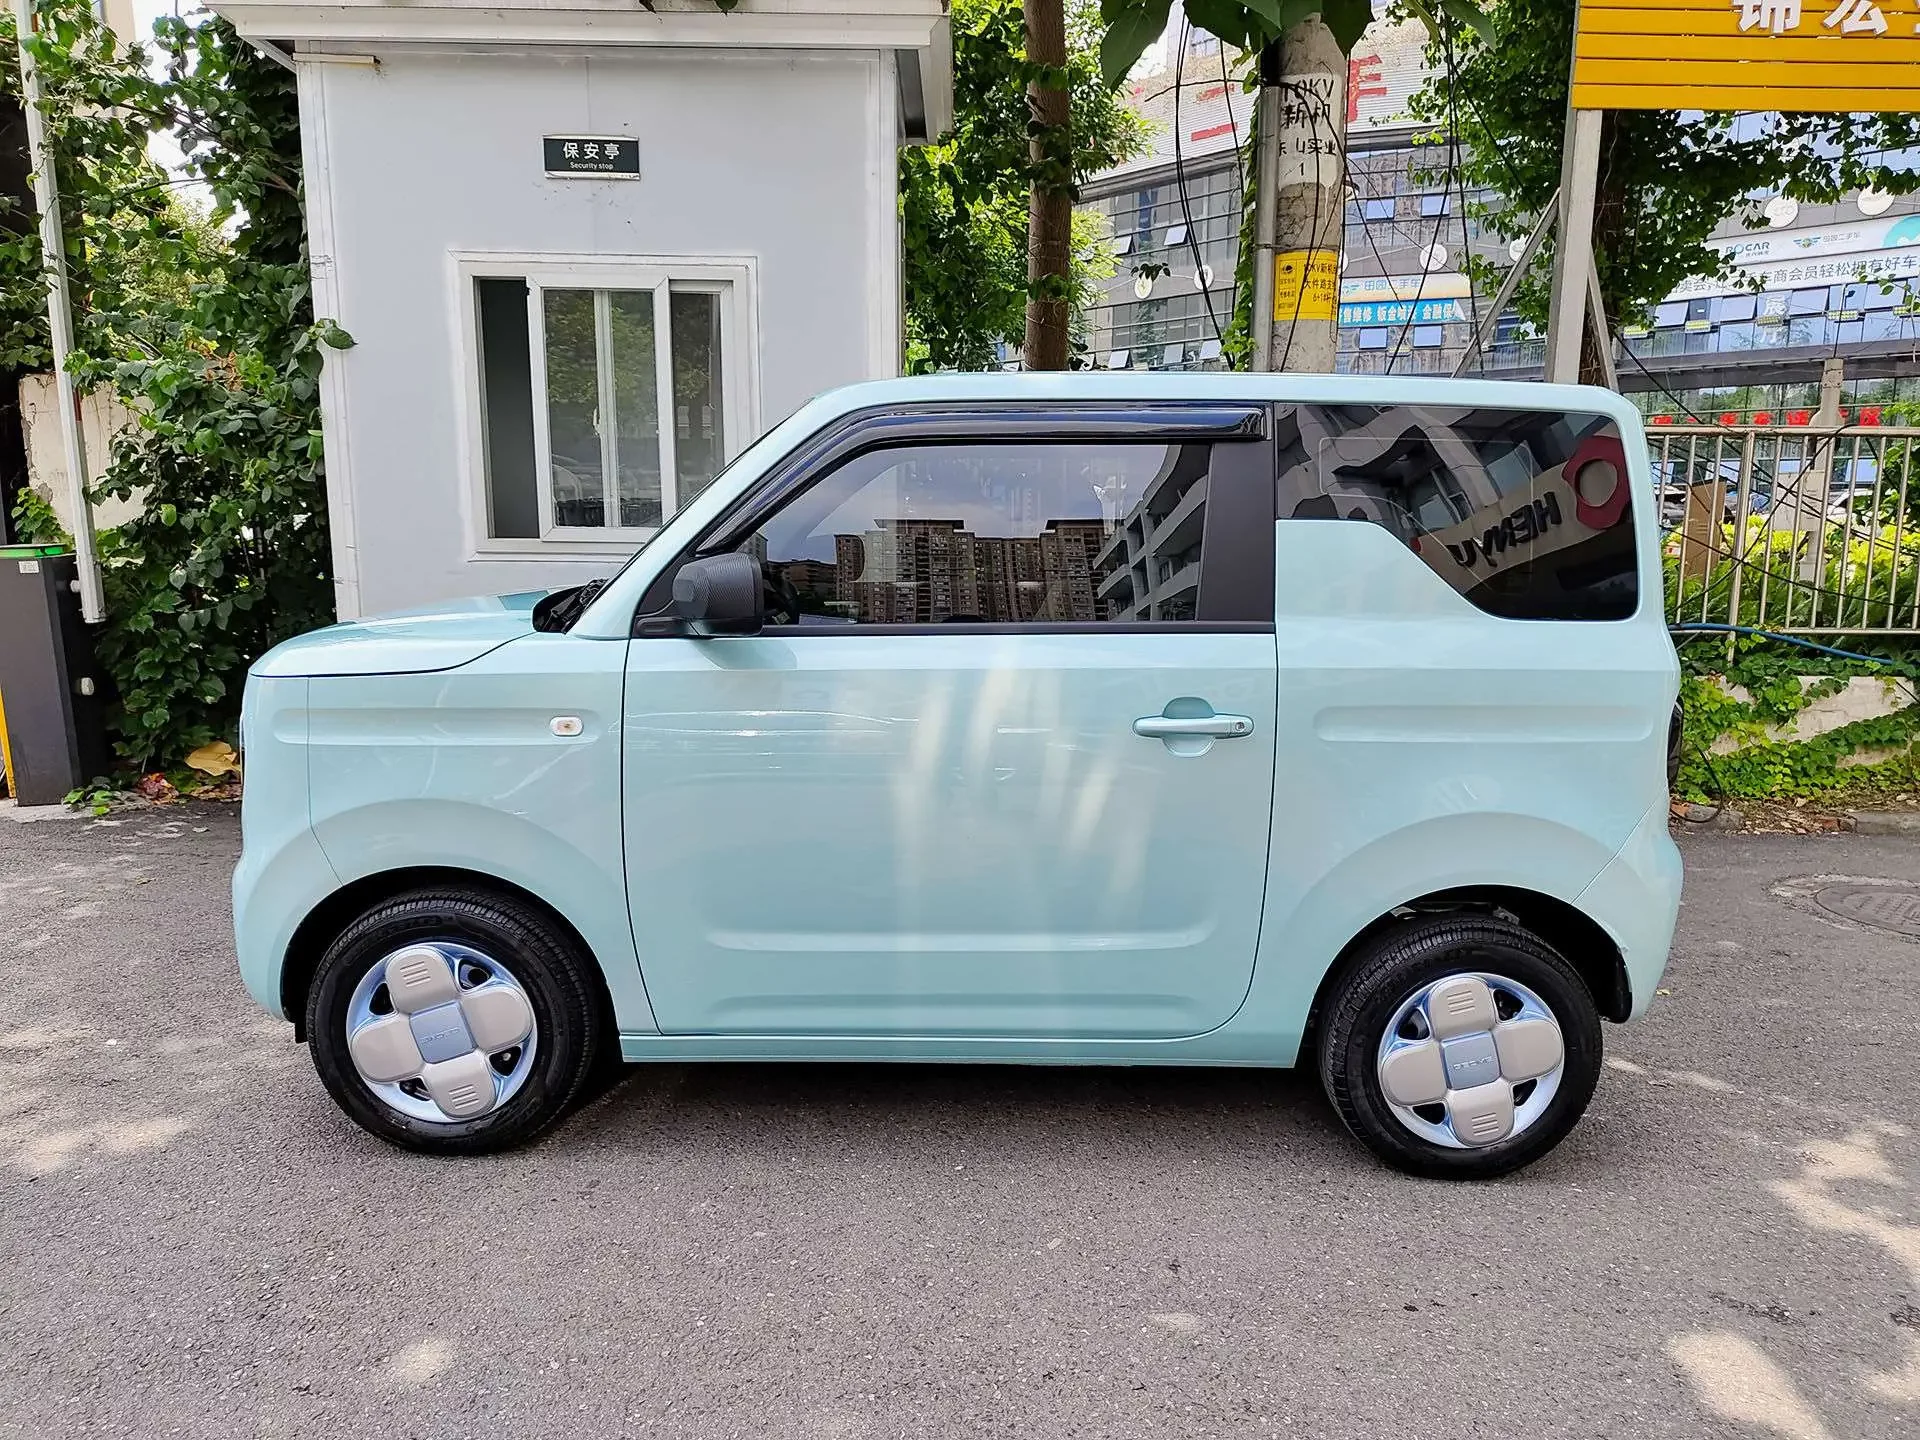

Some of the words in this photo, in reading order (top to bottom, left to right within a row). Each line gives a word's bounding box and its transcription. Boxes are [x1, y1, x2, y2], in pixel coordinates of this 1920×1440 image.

[562, 141, 620, 160] 保安亭
[570, 161, 598, 170] Security
[599, 163, 614, 171] stop
